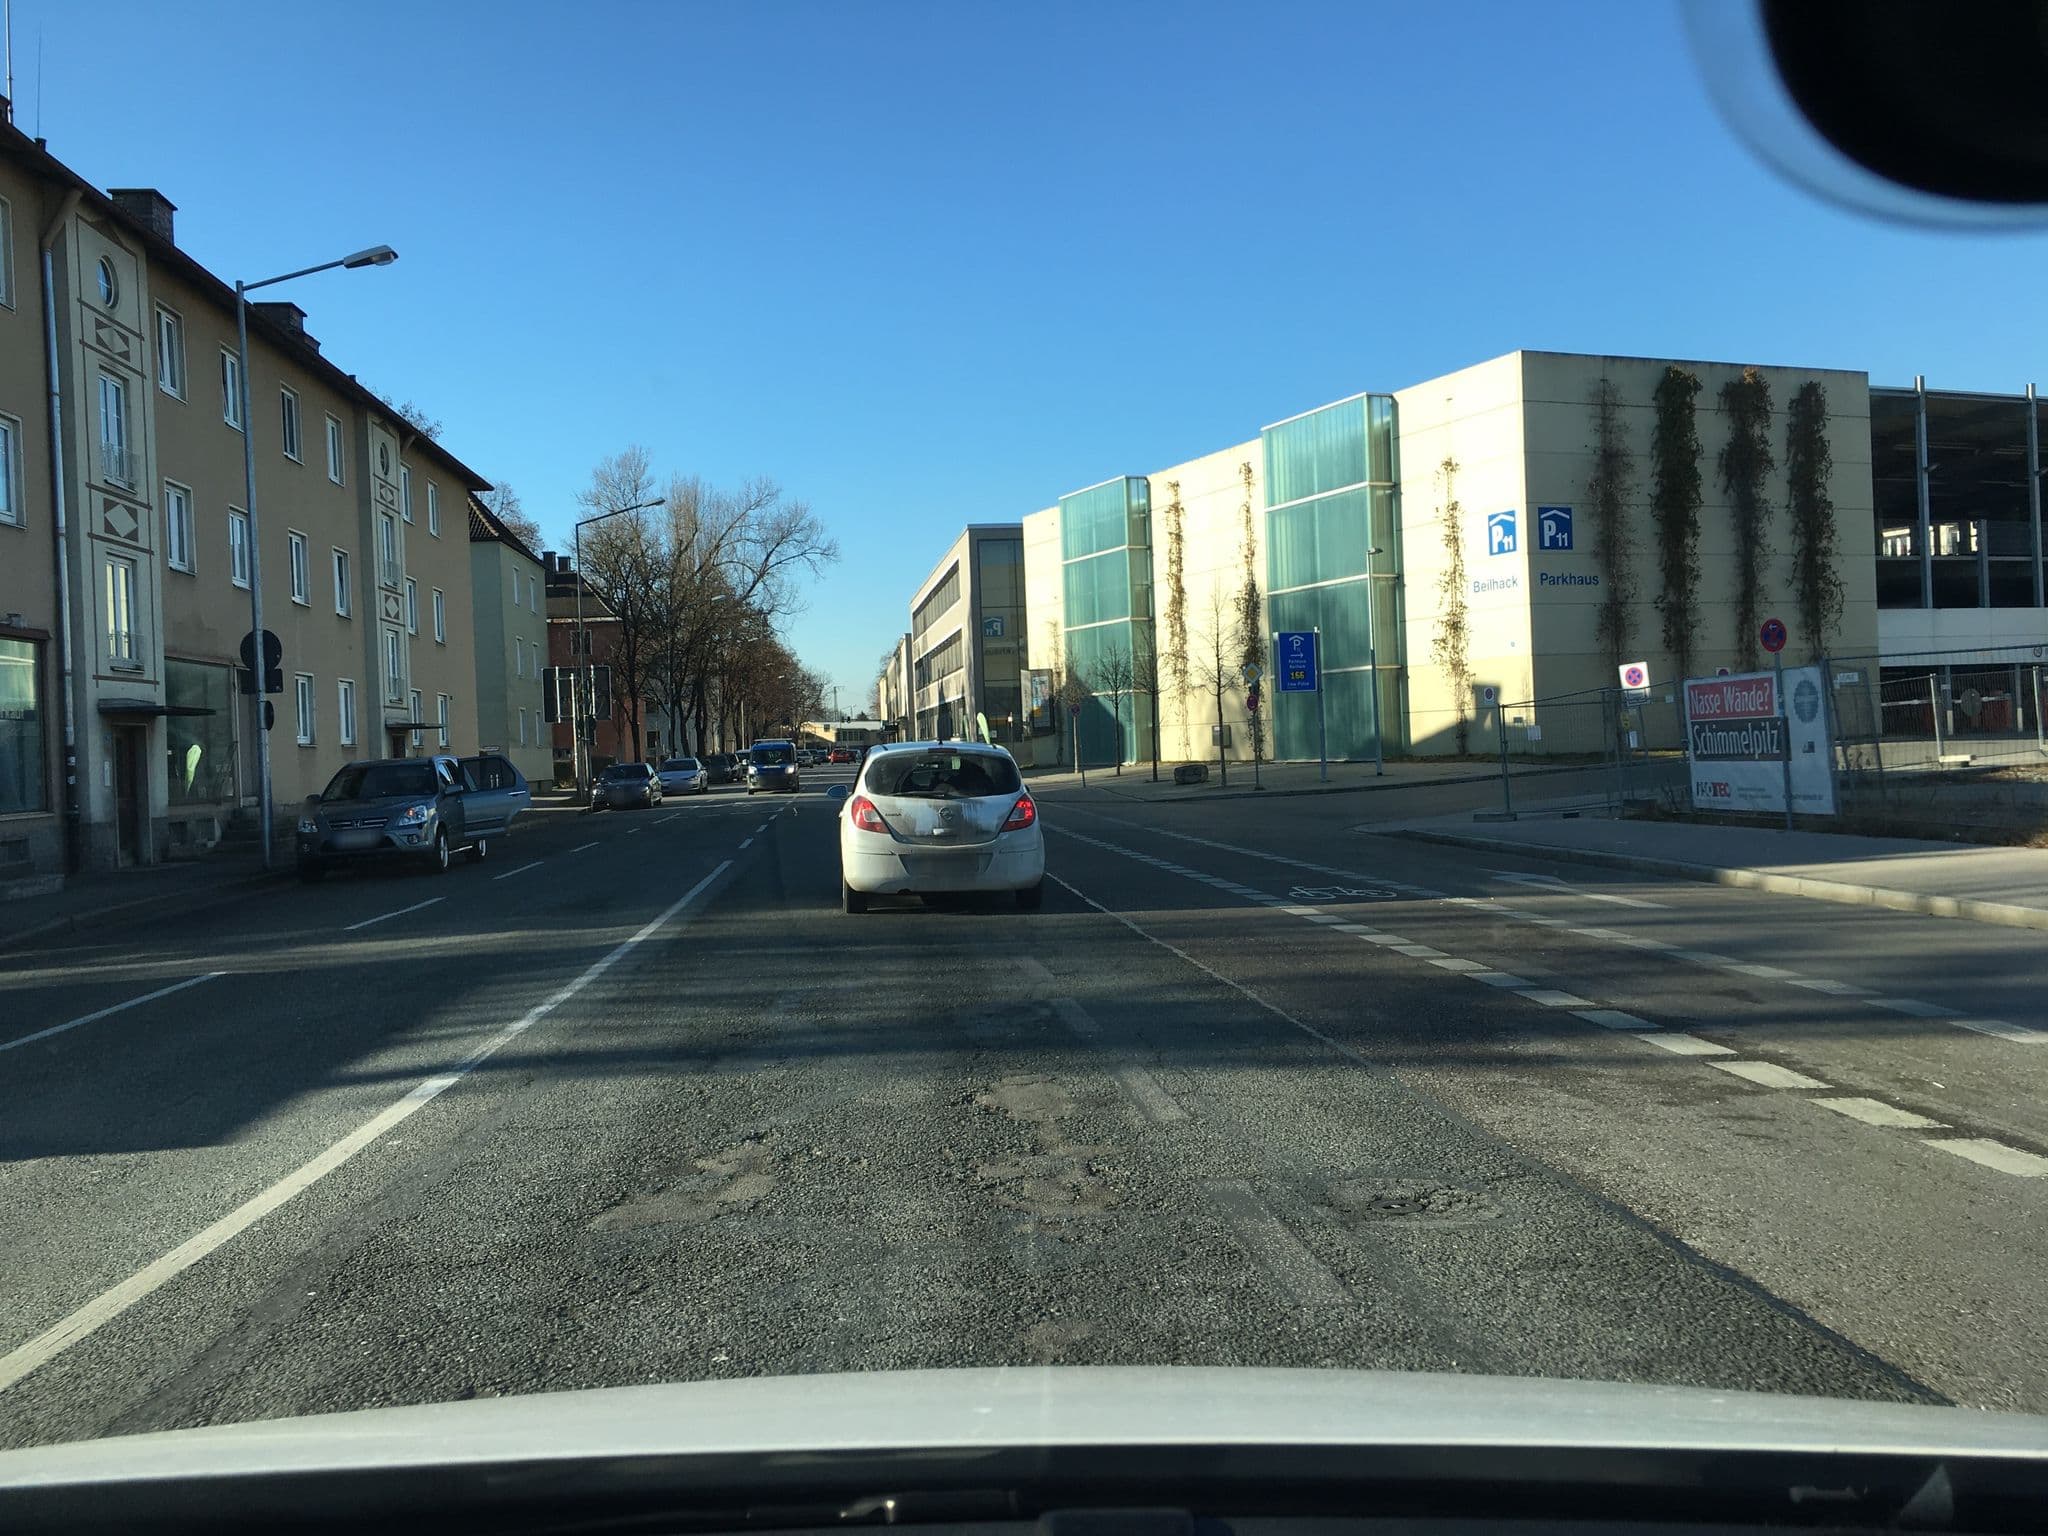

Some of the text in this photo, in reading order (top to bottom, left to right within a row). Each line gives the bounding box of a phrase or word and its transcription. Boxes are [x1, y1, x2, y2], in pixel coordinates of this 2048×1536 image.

[1473, 576, 1518, 593] Beilhack
[1540, 573, 1600, 586] Parkhaus
[1690, 683, 1769, 715] Nasse Wände?
[1693, 722, 1782, 759] Schimmelpilz
